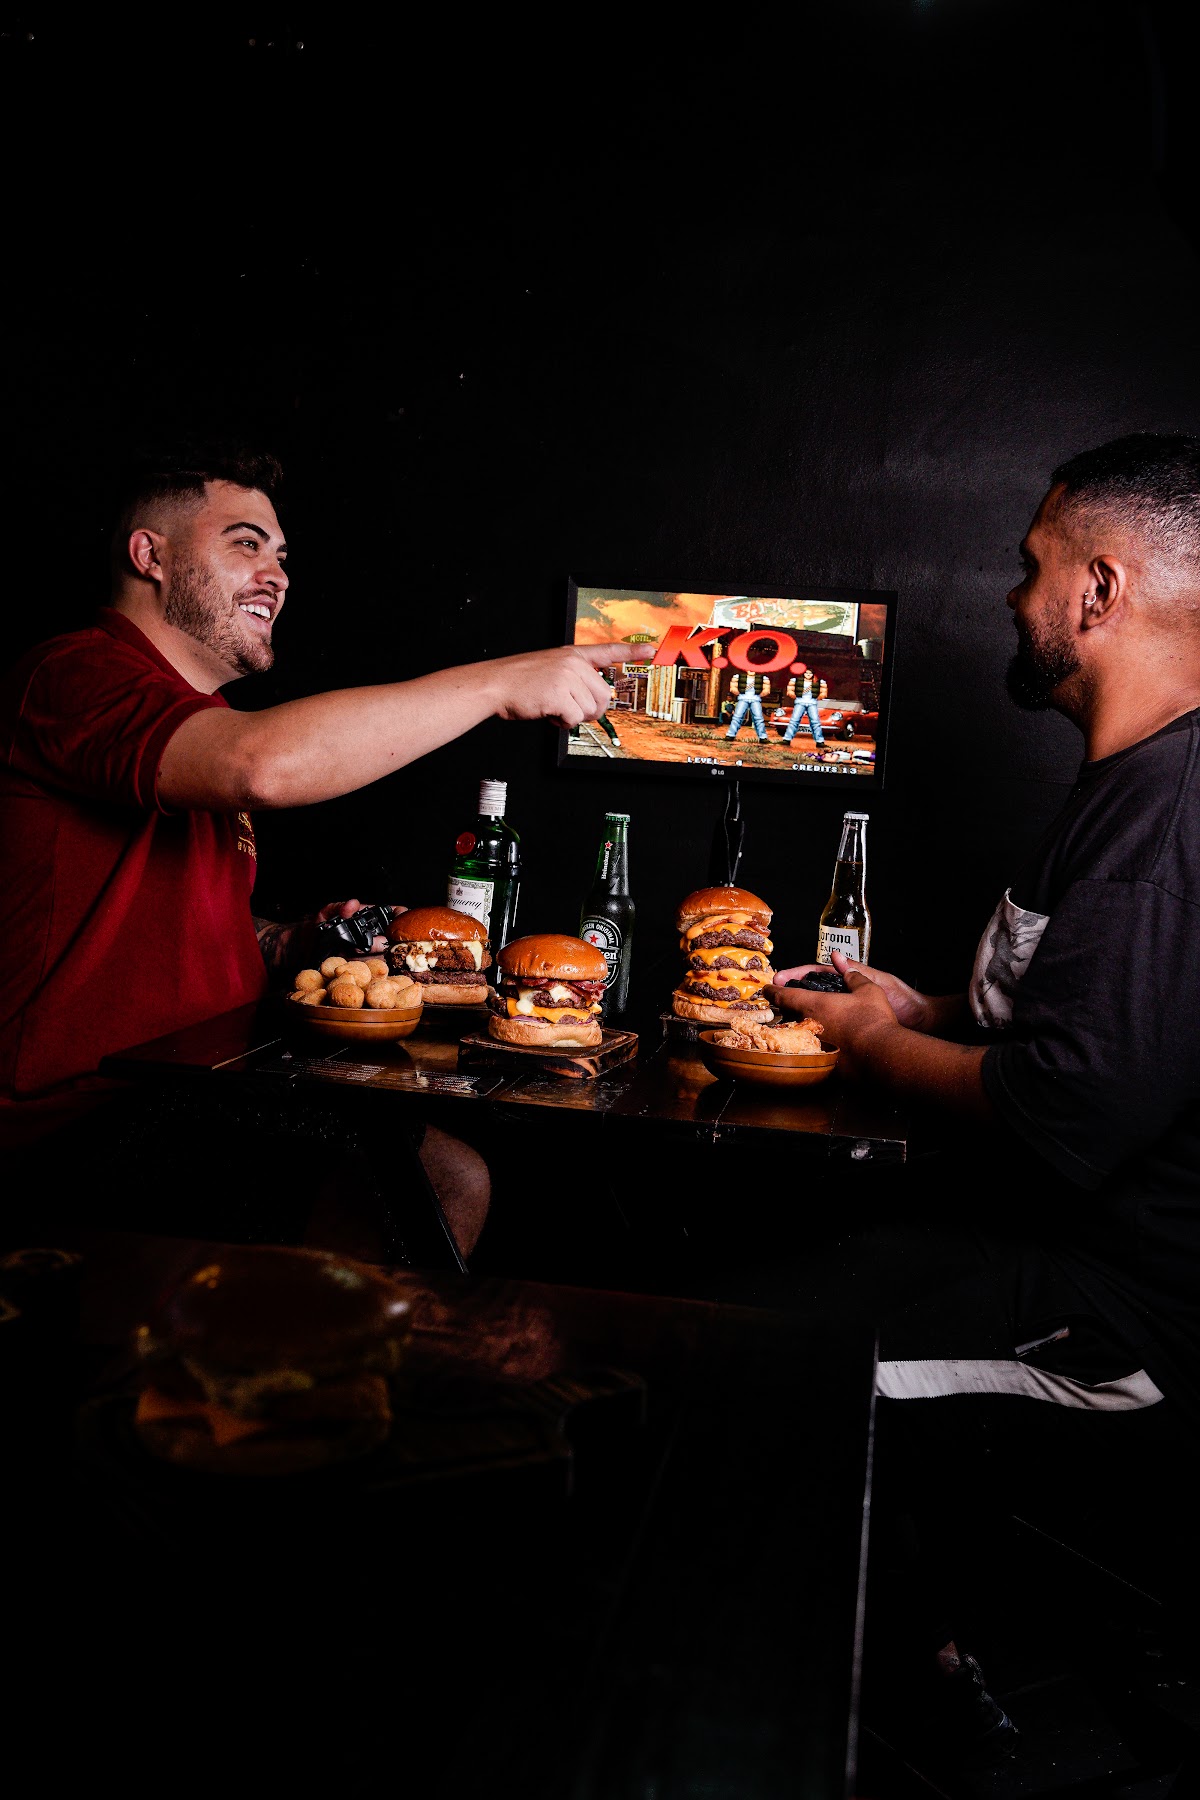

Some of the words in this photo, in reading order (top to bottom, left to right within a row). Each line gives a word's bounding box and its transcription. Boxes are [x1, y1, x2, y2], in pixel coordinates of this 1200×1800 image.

[652, 625, 807, 674] K.O.
[792, 763, 837, 773] CREDITS
[601, 851, 609, 879] Heineken
